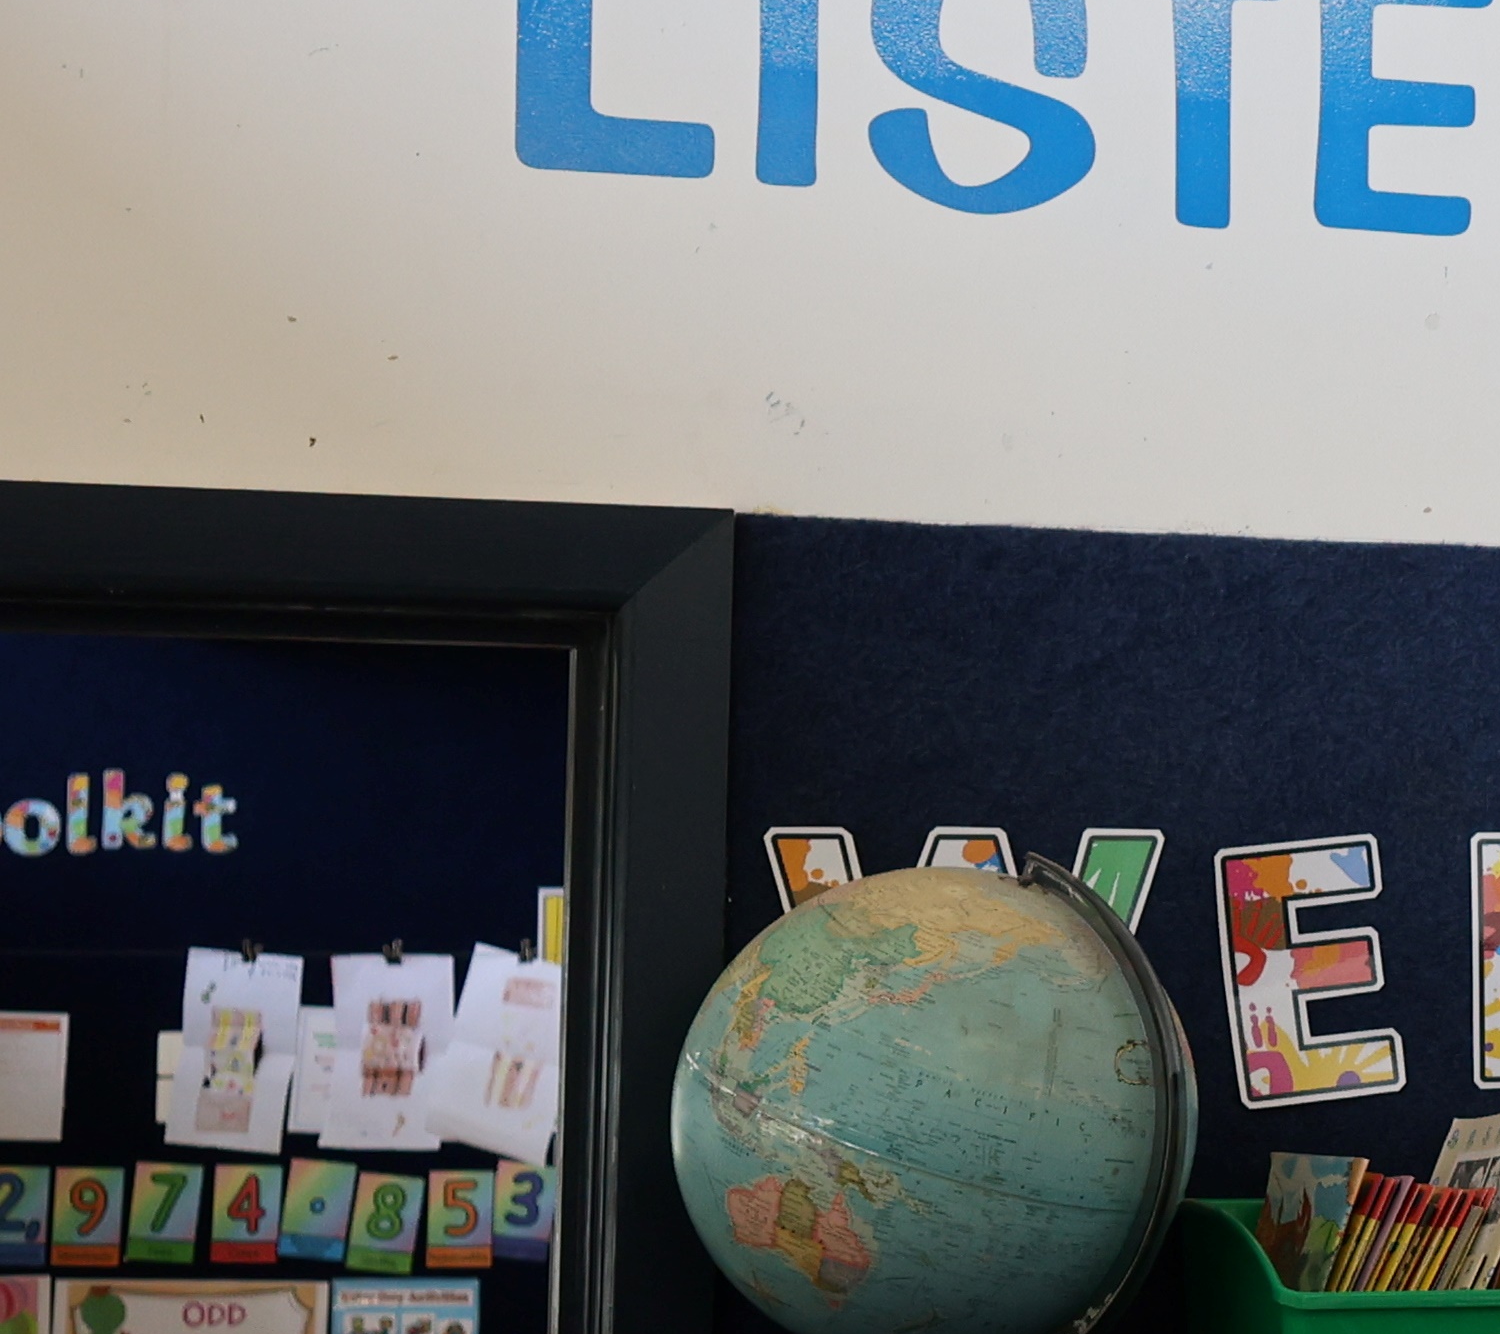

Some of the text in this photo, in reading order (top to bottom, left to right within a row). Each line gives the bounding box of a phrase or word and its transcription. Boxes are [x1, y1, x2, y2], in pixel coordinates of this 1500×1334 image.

[0, 770, 238, 856] olkit
[69, 1178, 107, 1236] 9
[150, 1173, 187, 1232] 7
[227, 1174, 266, 1233] 4
[366, 1182, 408, 1239] 8
[441, 1179, 479, 1236] 5
[505, 1172, 543, 1226] 3
[182, 1301, 246, 1329] ODD
